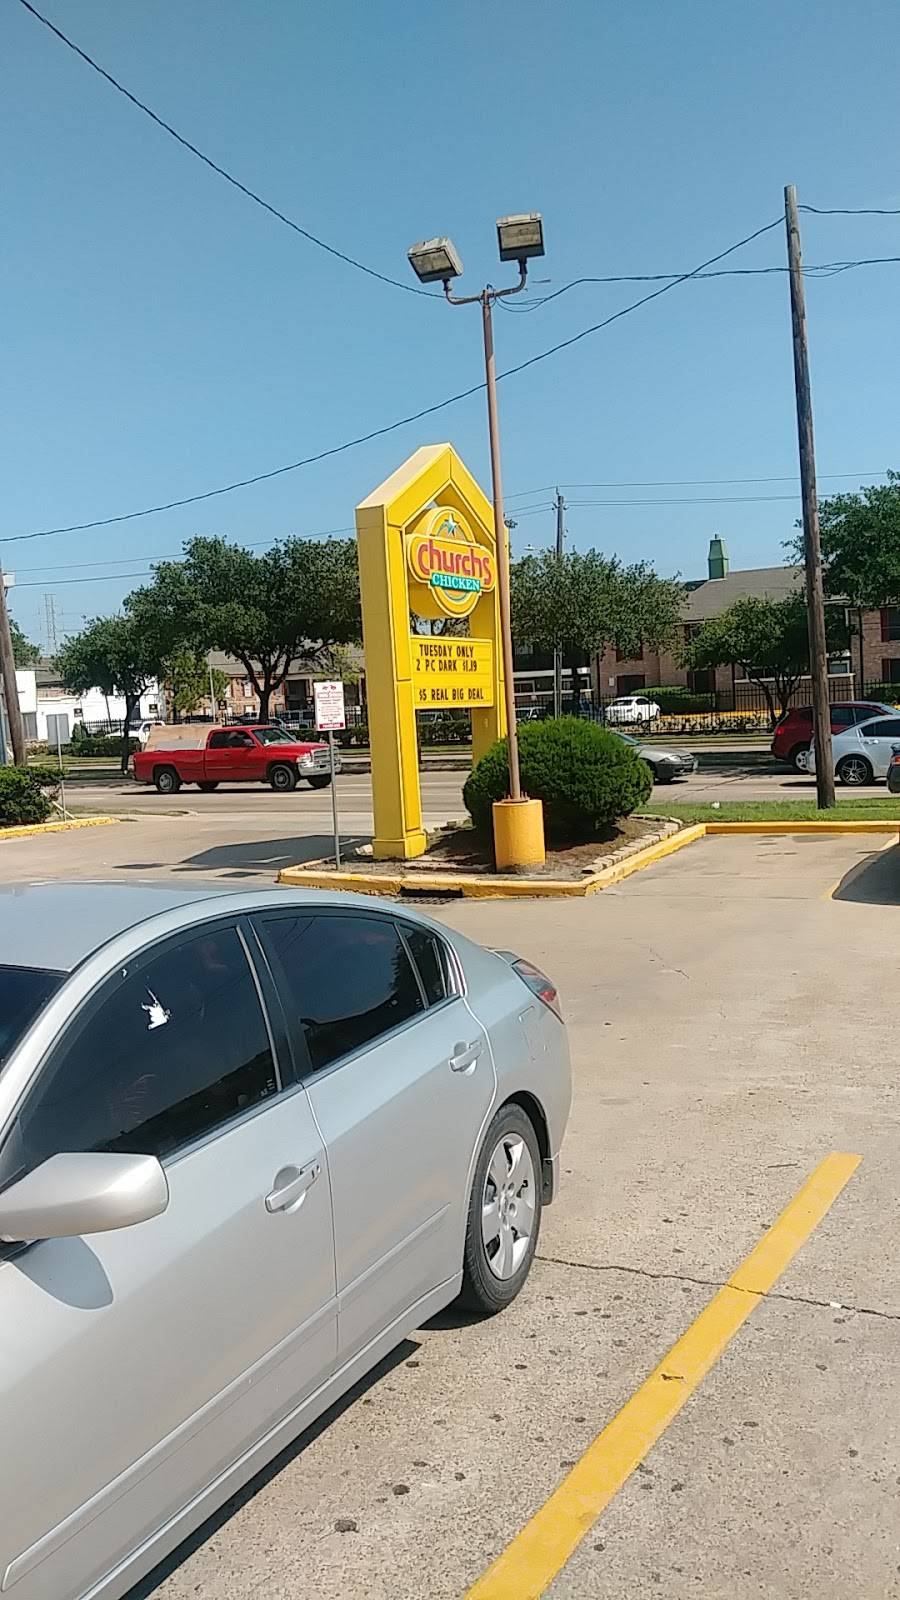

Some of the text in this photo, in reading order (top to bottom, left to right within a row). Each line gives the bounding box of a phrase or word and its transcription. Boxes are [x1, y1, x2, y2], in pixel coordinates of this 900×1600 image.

[432, 573, 480, 591] CHICKEN
[419, 644, 474, 658] TUESDAY ONLY
[416, 659, 421, 672] 2
[425, 659, 436, 672] PC
[439, 659, 457, 672] DARK
[419, 688, 484, 701] $5 REAL BIG DEAL
